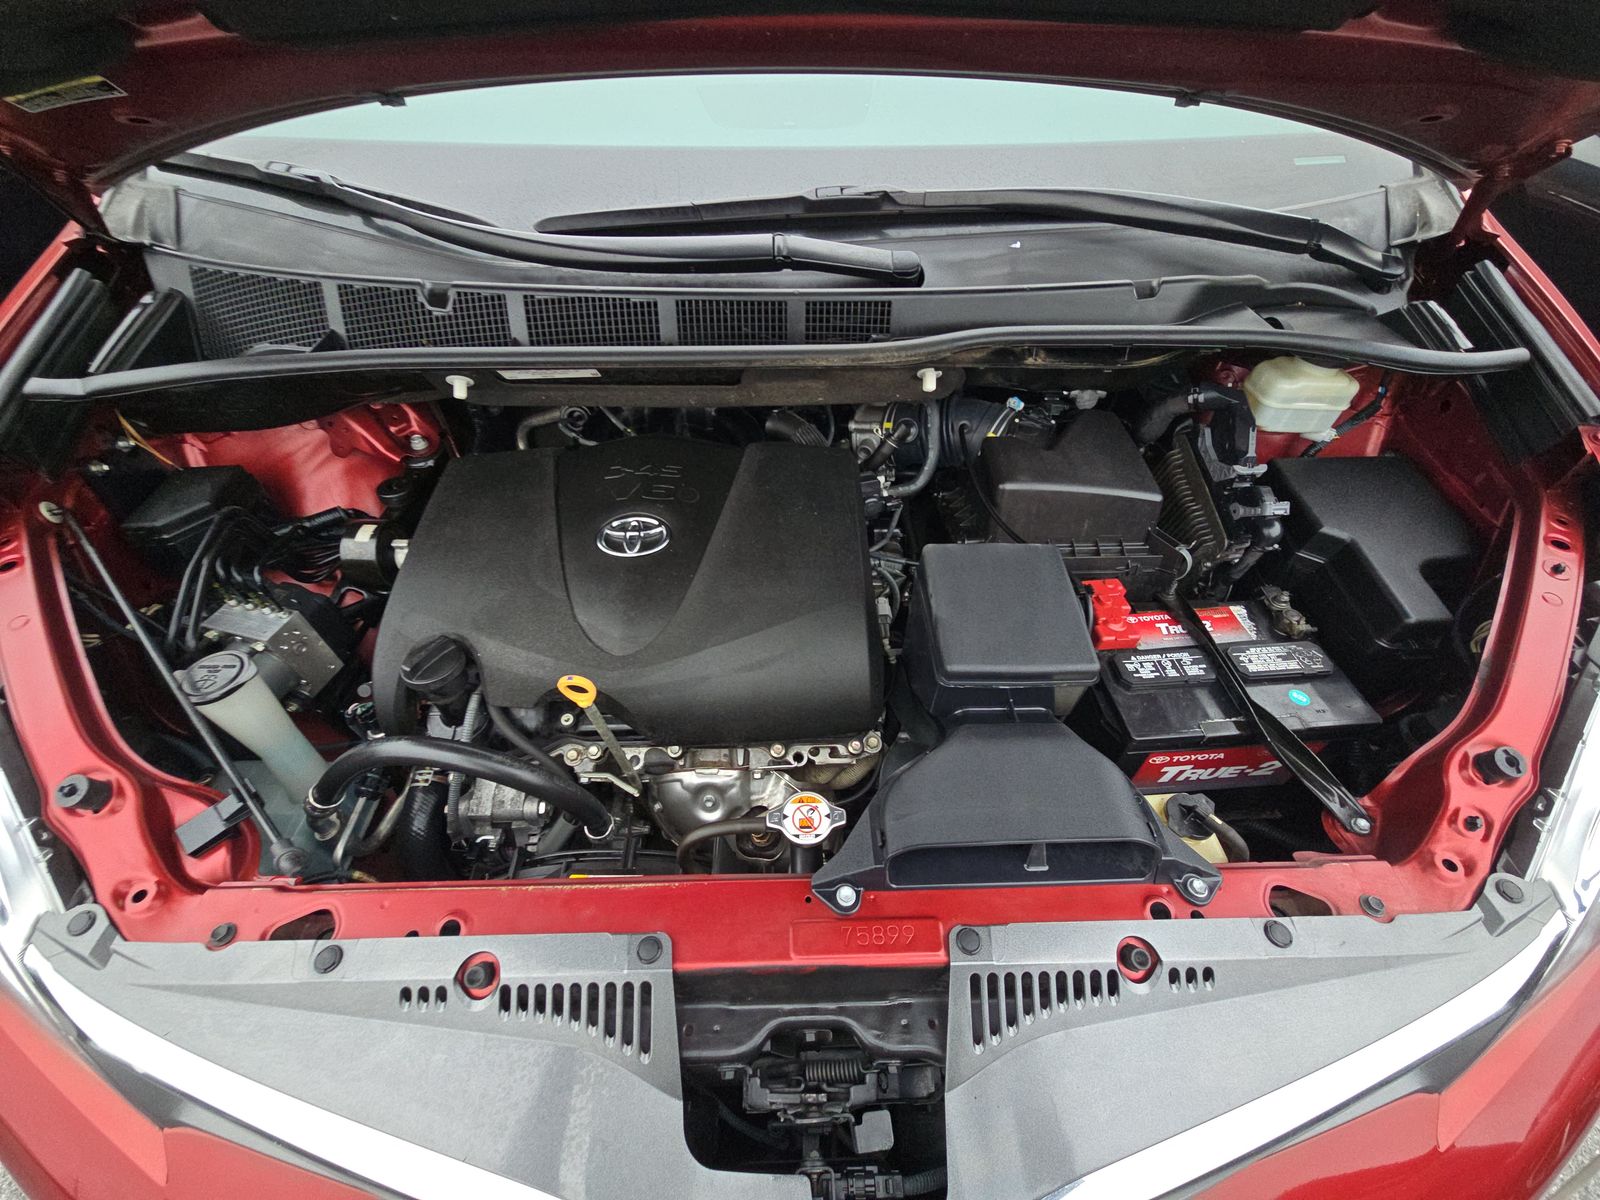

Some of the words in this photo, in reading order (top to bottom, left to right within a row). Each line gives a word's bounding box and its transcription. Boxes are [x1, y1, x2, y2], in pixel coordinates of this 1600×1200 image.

[1137, 614, 1172, 623] TOYOTA
[1172, 753, 1225, 763] TOYOTA
[1157, 760, 1283, 783] TRUE-2
[840, 924, 915, 946] 75899
